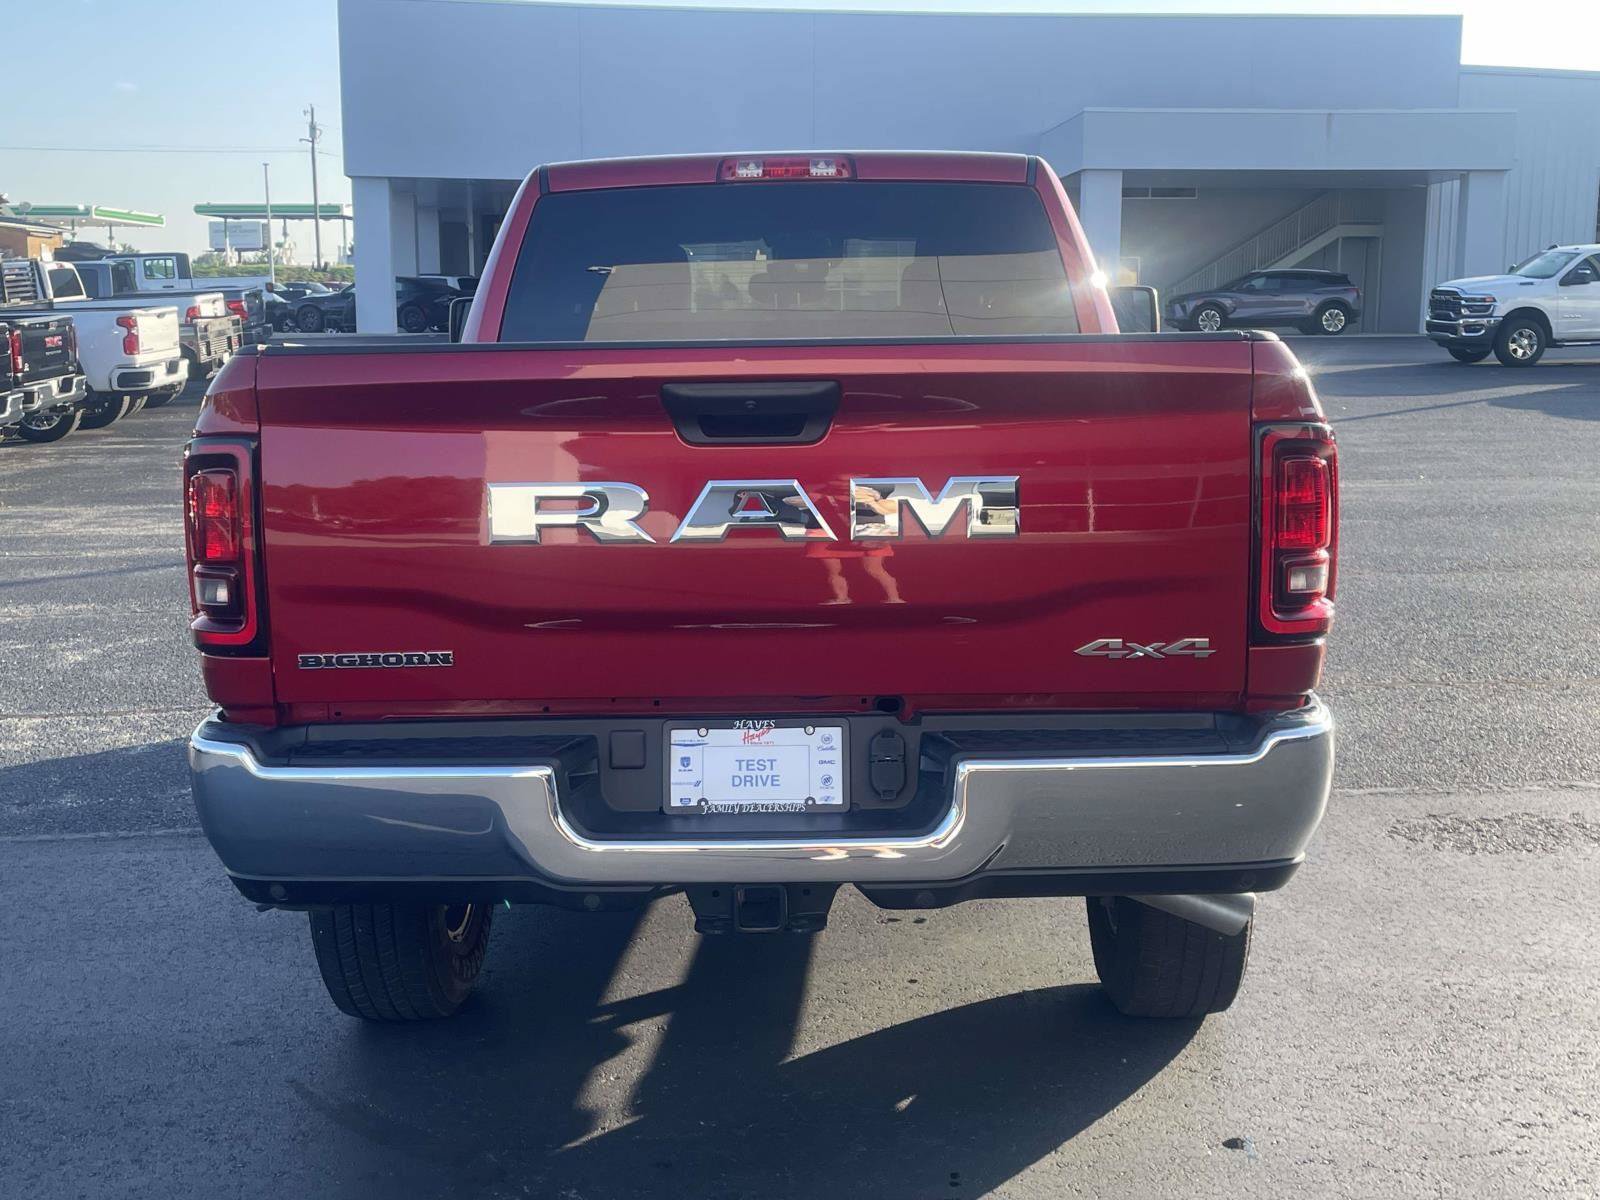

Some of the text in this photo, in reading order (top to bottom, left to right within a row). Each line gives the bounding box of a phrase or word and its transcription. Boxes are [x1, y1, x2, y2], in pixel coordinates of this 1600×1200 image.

[487, 476, 1020, 545] RAM
[1074, 637, 1216, 659] 4x4
[298, 651, 453, 669] BIGHORN
[733, 719, 776, 731] HAYES
[735, 759, 777, 772] TEST
[731, 775, 781, 787] DRIVE
[702, 801, 806, 815] FAMILY DEALERSHIPS
